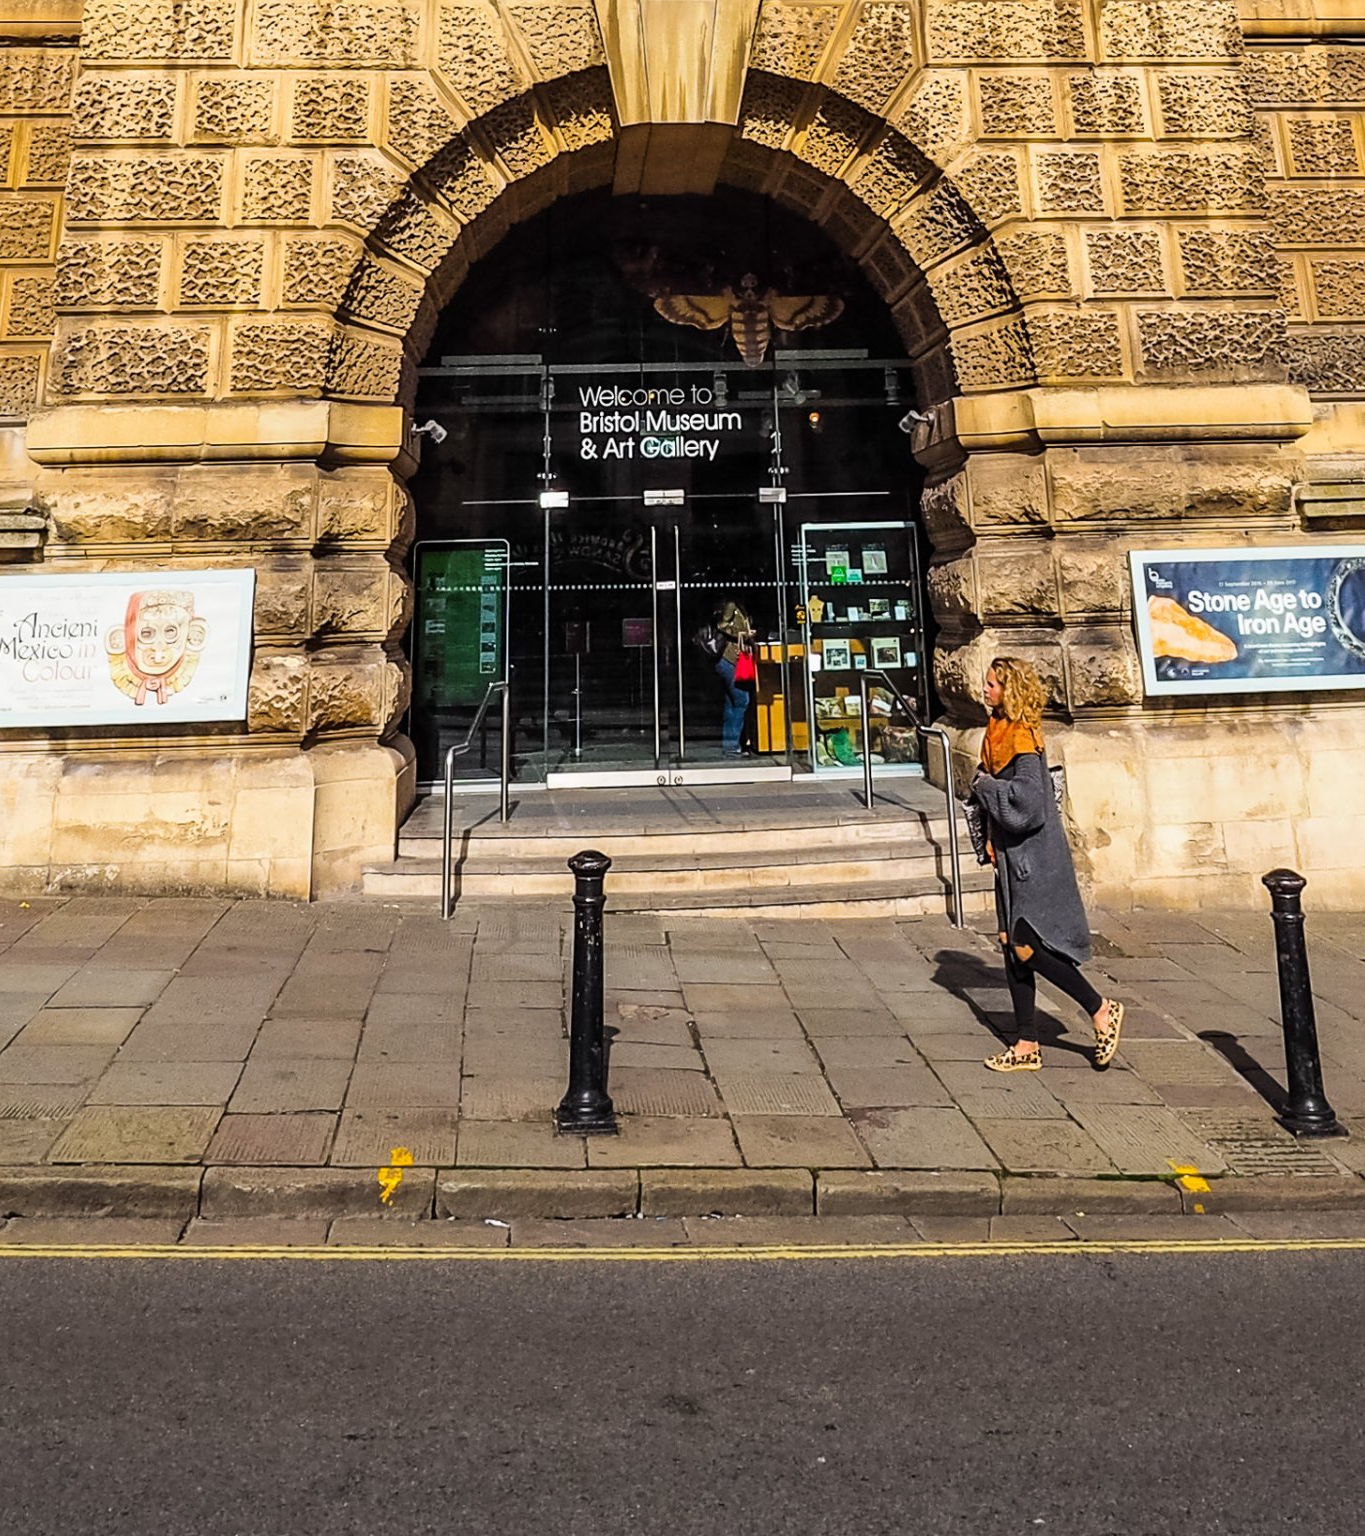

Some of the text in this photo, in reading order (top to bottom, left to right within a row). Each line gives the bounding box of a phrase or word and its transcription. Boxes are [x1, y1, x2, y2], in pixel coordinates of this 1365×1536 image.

[579, 384, 712, 407] Welcome to
[580, 410, 742, 433] Bristol Museum
[580, 436, 719, 461] & Art Gallery
[1188, 589, 1322, 615] Stone Age to
[1237, 614, 1327, 638] Iron Age
[78, 639, 96, 659] in
[22, 659, 95, 683] Colour
